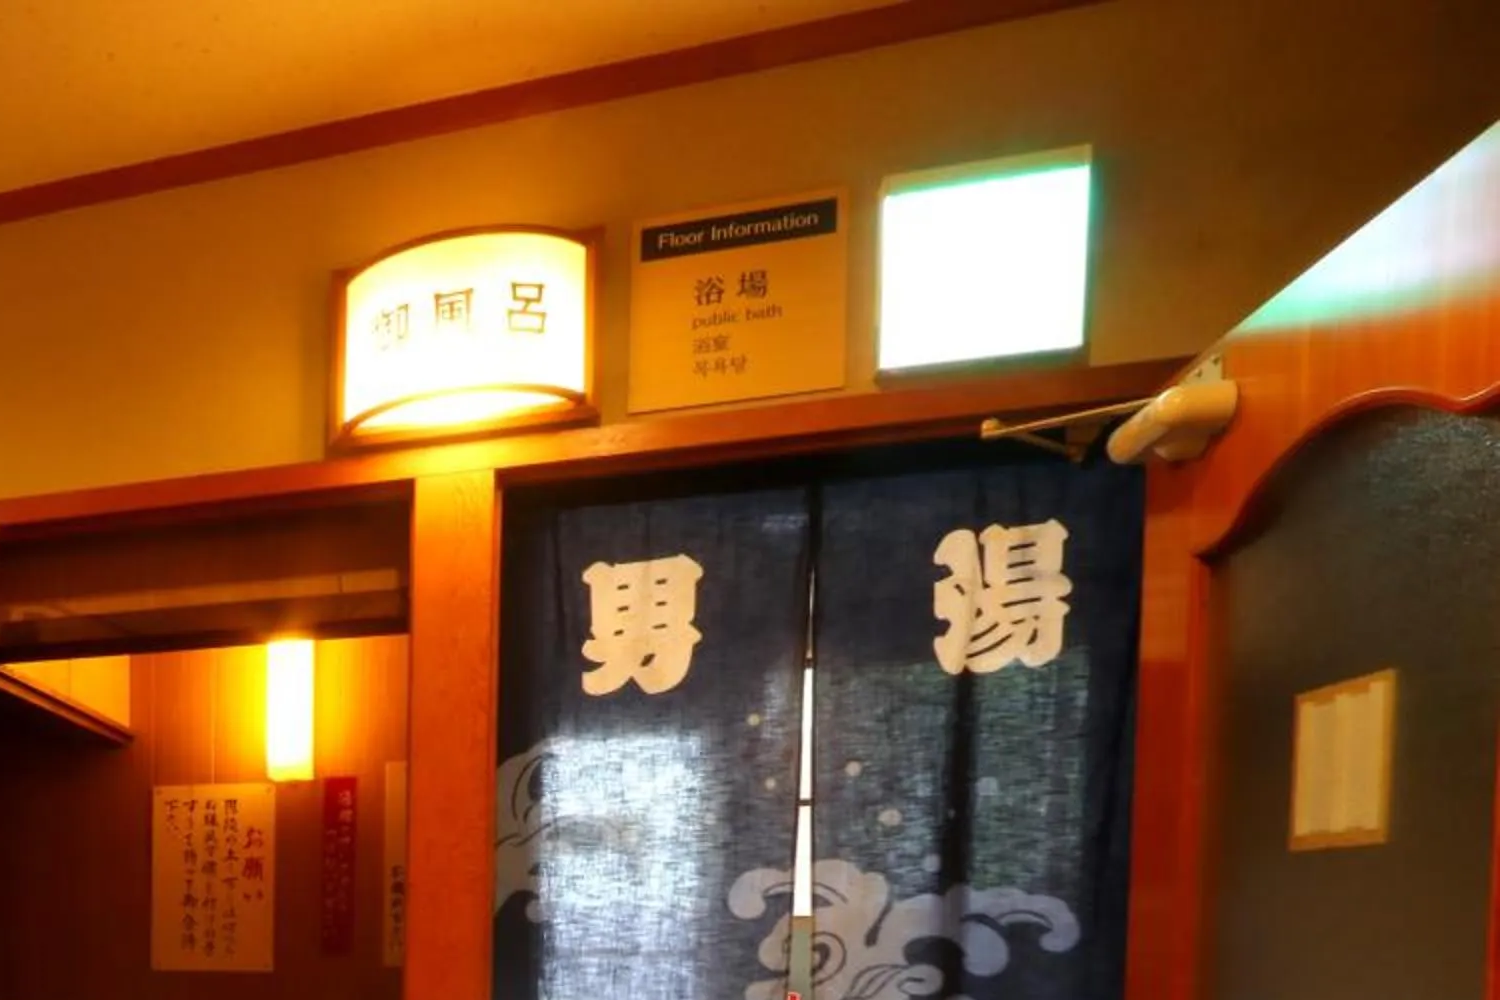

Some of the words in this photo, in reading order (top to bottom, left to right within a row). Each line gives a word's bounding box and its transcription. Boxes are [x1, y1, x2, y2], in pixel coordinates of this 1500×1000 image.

[657, 230, 705, 251] Floor
[710, 211, 820, 242] Information
[693, 268, 769, 307] 浴場
[691, 310, 739, 330] public
[744, 303, 784, 323] bath
[581, 553, 705, 697] 男
[933, 518, 1073, 676] 湯
[242, 826, 265, 904] お願い
